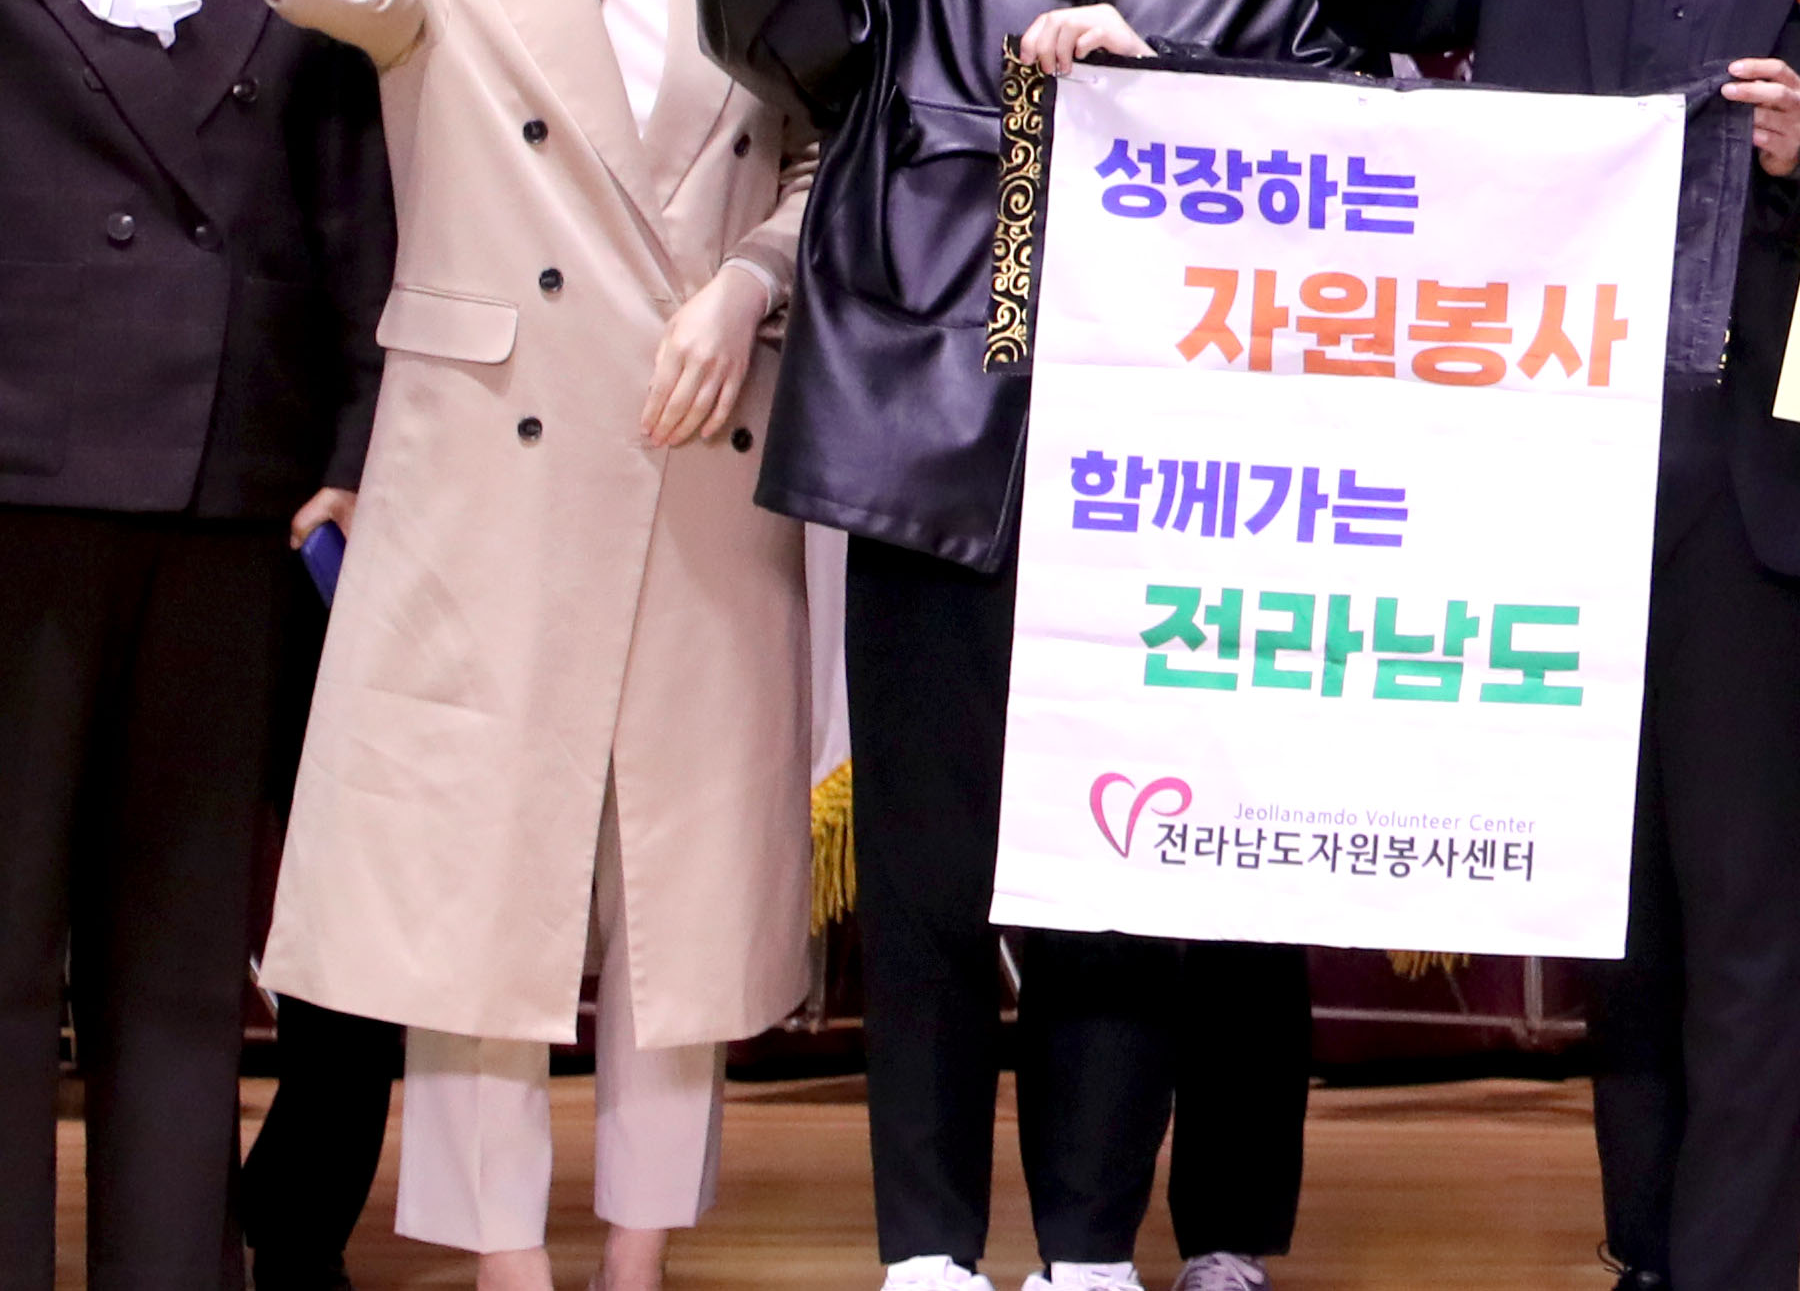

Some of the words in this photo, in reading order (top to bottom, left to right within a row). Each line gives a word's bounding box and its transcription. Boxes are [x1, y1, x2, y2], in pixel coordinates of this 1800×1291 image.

[1095, 138, 1420, 234] 성장하는
[1177, 265, 1628, 388] 자원봉사
[1070, 450, 1409, 548] 함께가는
[1138, 584, 1584, 707] 전라남도
[1154, 823, 1534, 881] 전라남도자원봉사센터
[1234, 803, 1357, 826] Jeollanamdo
[1366, 810, 1460, 830] Volunteer
[1469, 815, 1535, 834] Center
